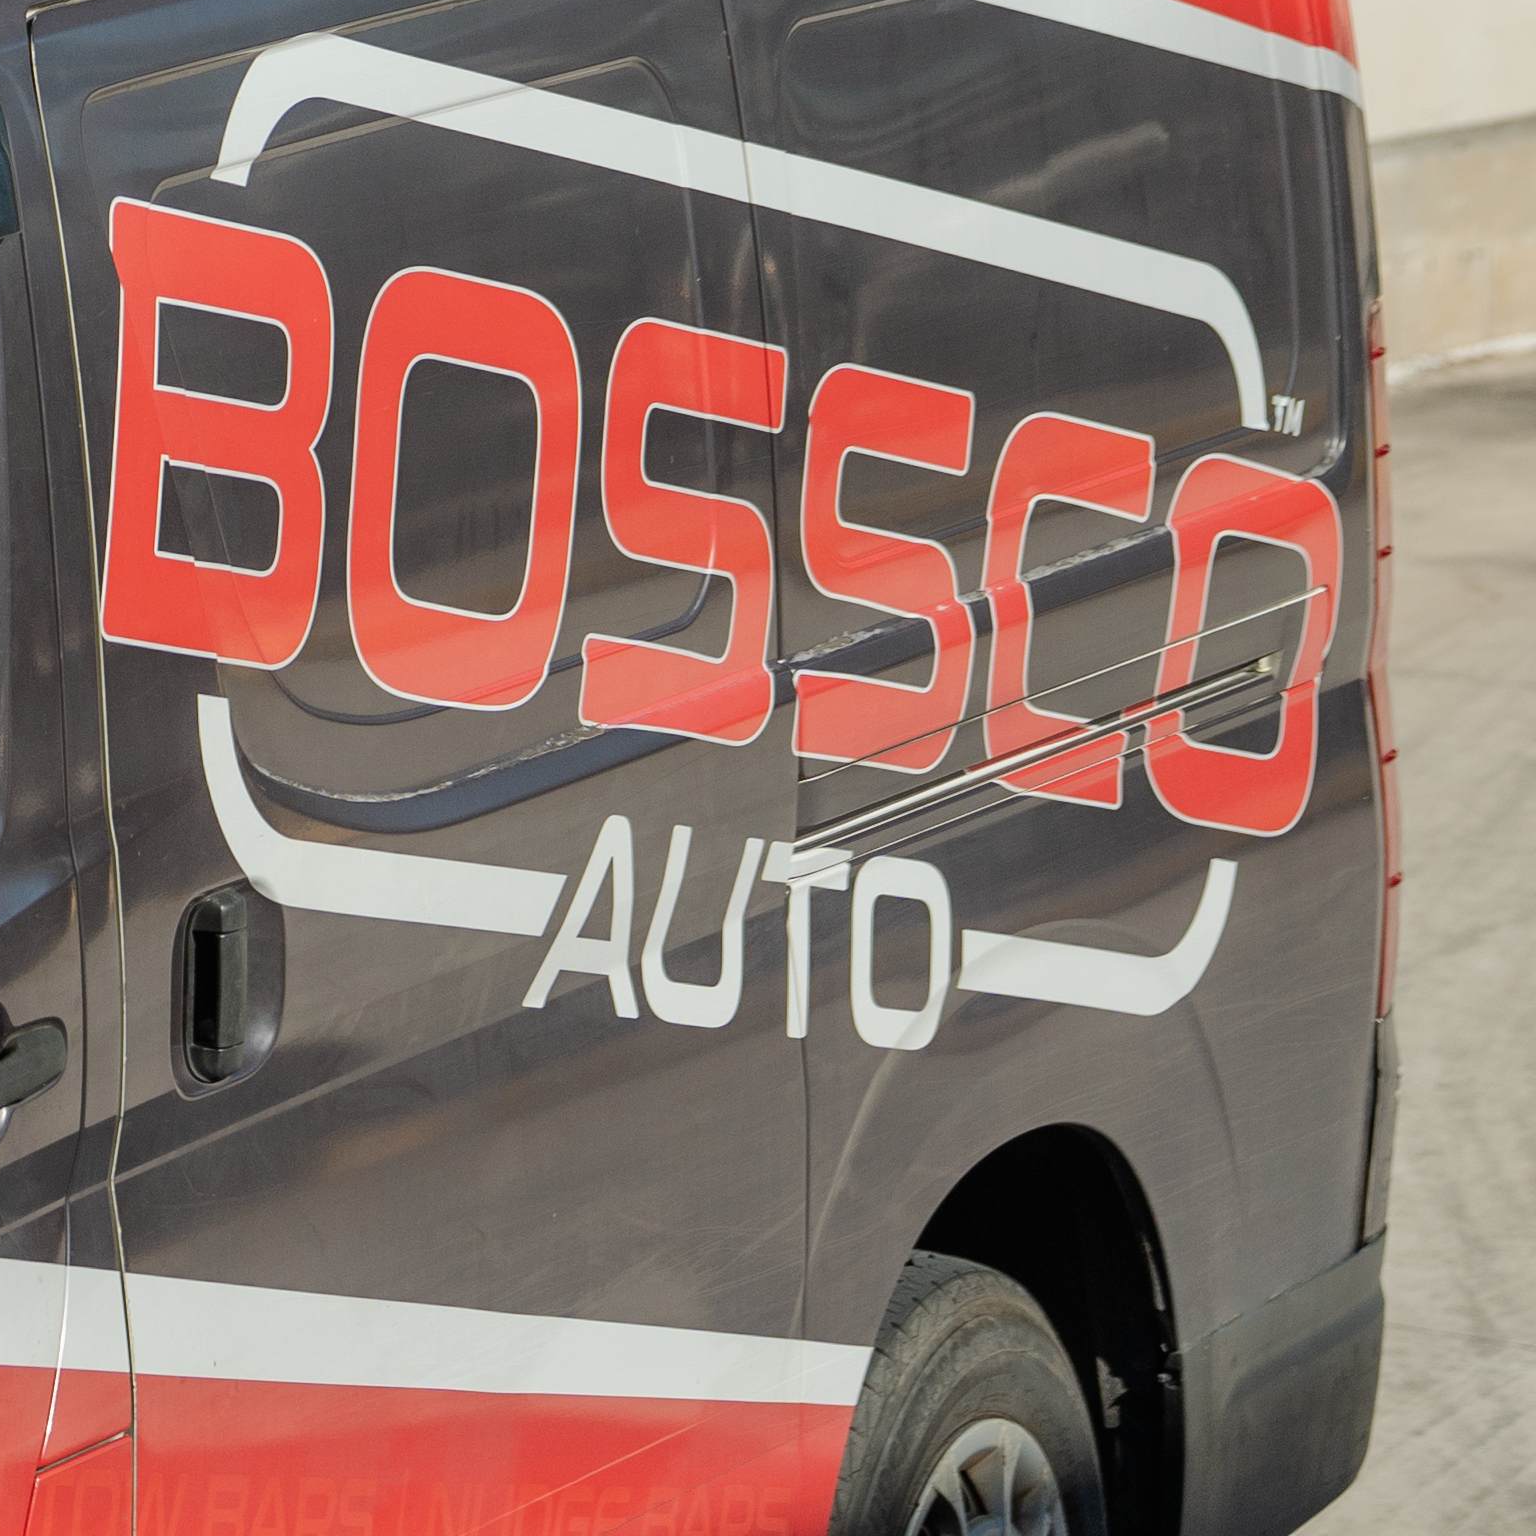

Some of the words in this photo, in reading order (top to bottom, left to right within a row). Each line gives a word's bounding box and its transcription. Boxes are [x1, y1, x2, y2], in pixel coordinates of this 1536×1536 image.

[1271, 394, 1305, 437] TM
[100, 197, 1343, 836] BOSSCO
[522, 816, 952, 1051] AUTO
[203, 1474, 377, 1536] BARS
